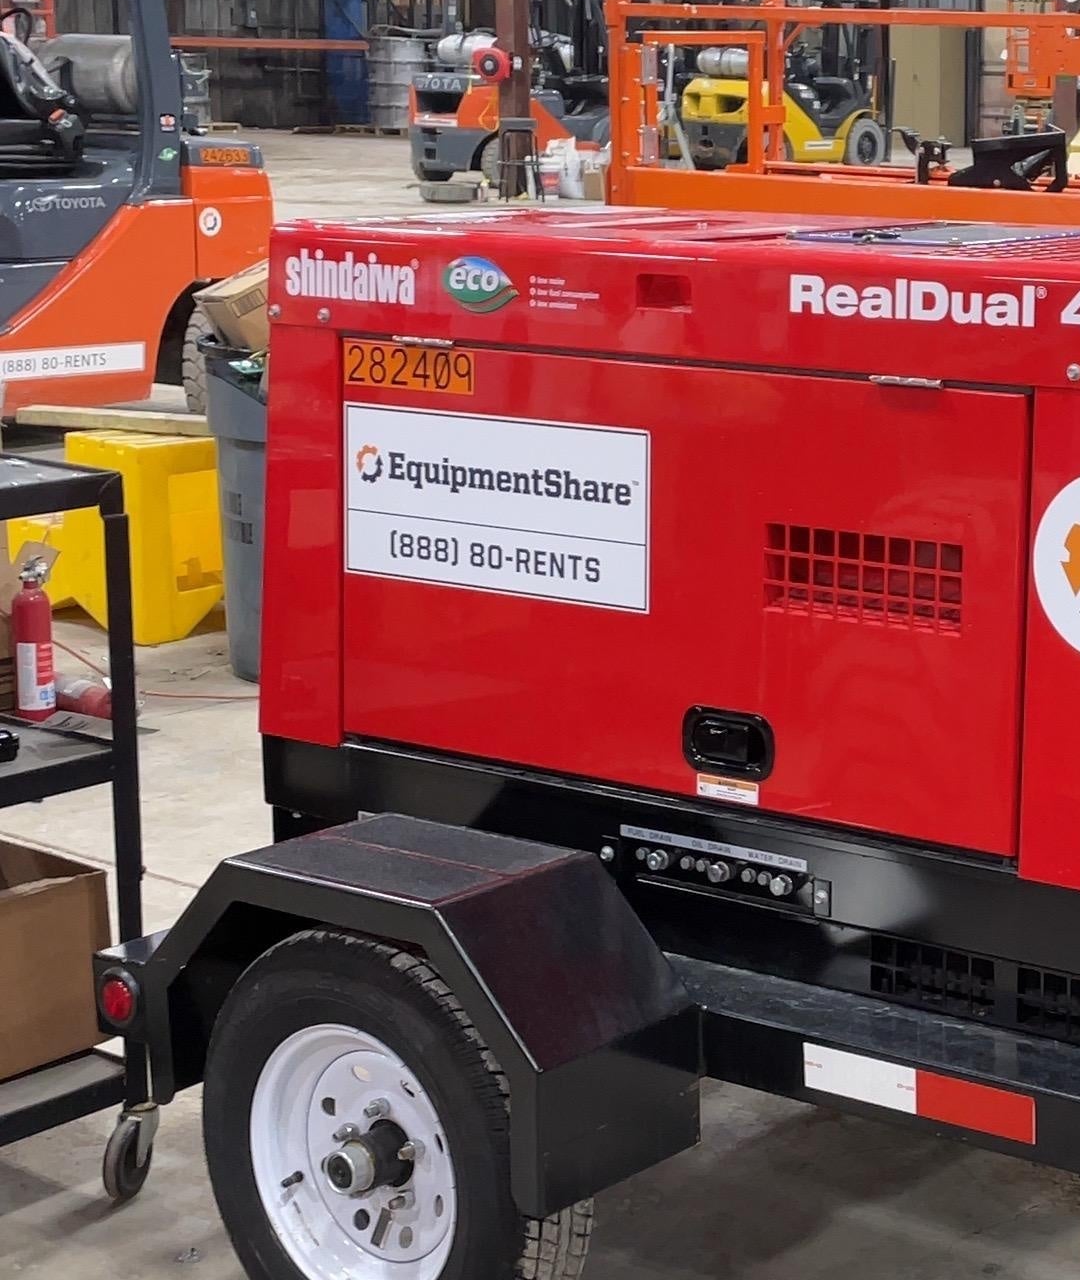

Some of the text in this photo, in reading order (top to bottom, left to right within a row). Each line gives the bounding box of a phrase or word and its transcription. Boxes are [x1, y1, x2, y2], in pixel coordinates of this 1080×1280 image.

[53, 197, 106, 210] TOYOTA
[450, 269, 500, 292] eco
[3, 352, 107, 375] (888) 80-RENTS
[347, 344, 473, 393] 282409
[390, 530, 601, 583] (888) 80-RENTS
